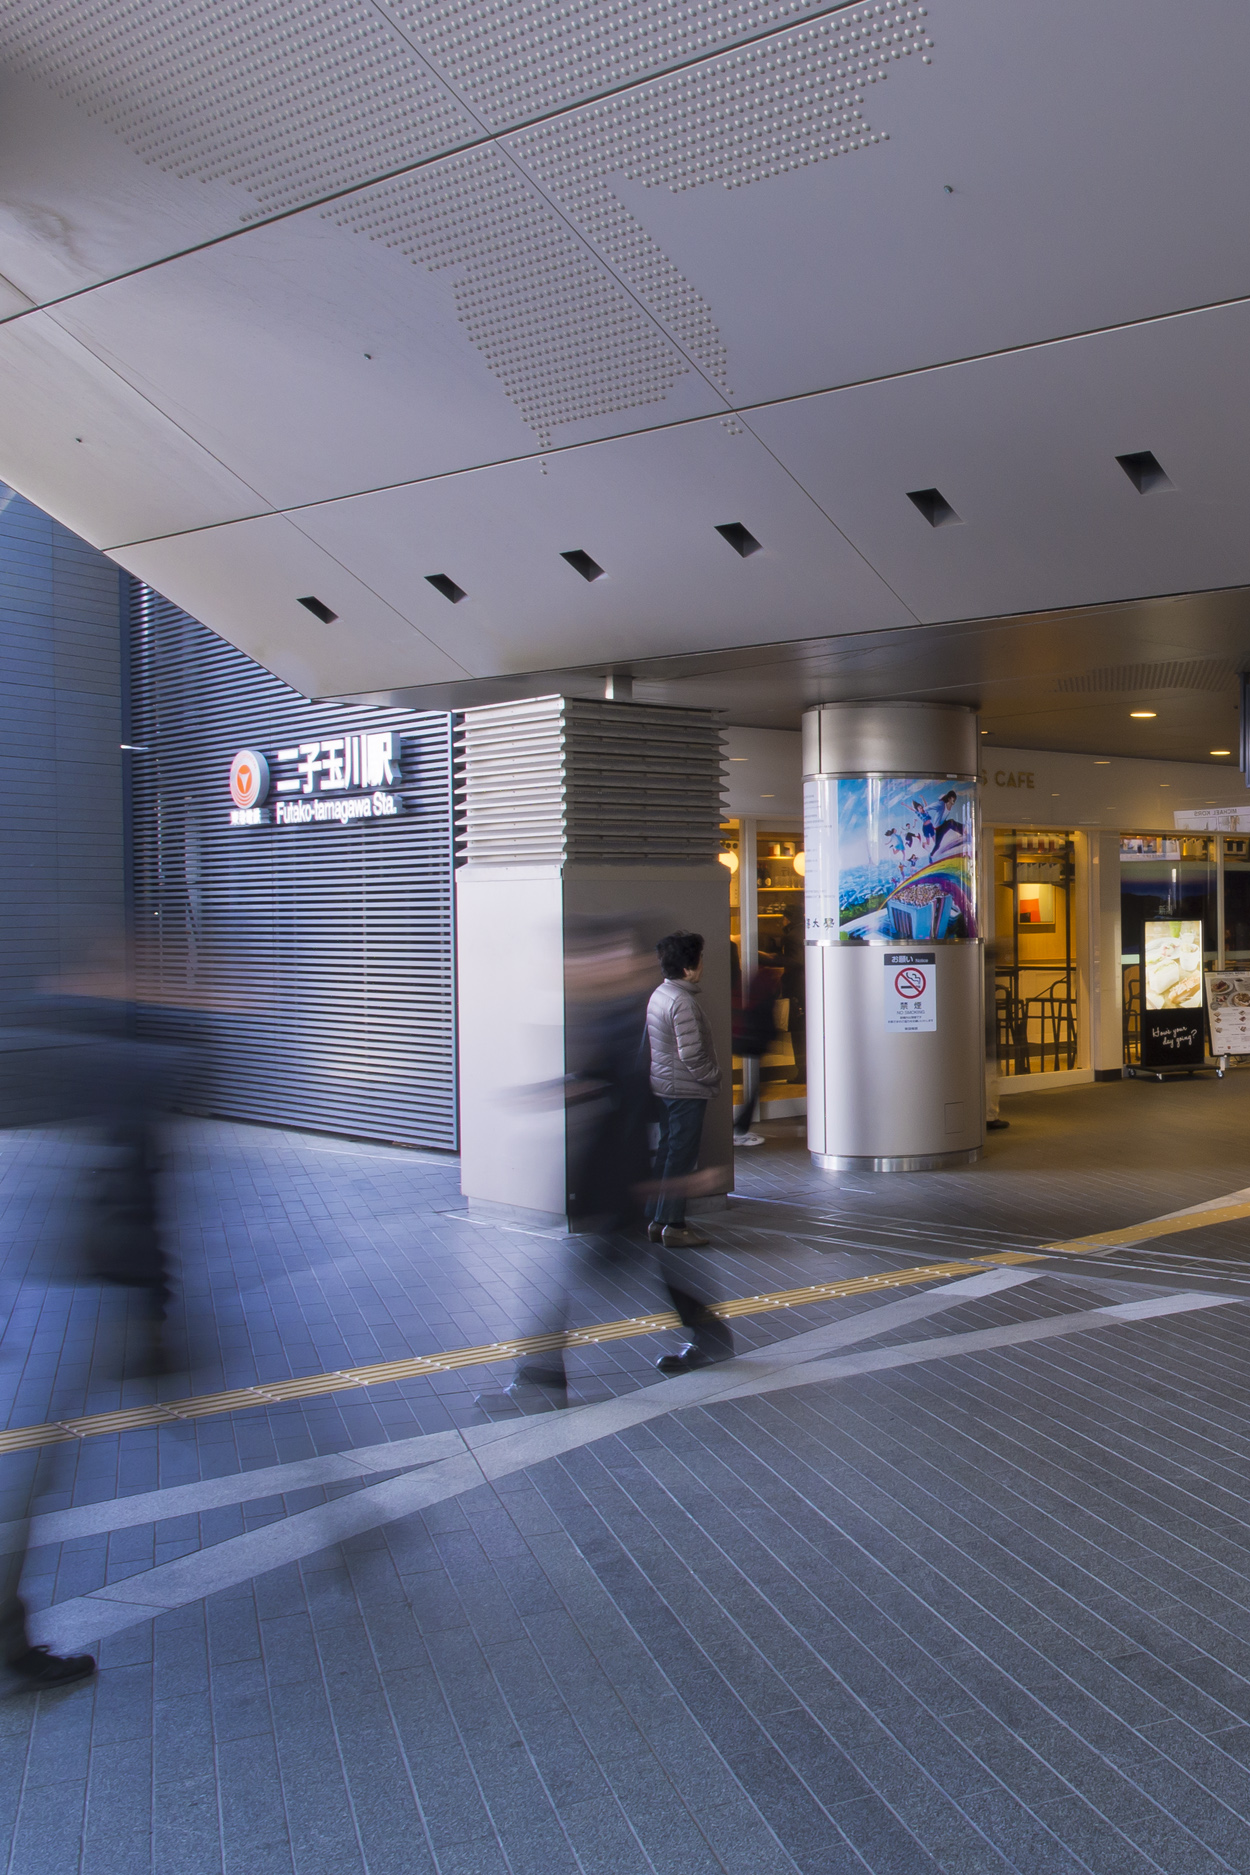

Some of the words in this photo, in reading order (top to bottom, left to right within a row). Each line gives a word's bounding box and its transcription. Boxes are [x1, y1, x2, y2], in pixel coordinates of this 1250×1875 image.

[276, 732, 394, 793] 二子玉川駅
[994, 770, 1034, 789] CAFE
[276, 797, 371, 825] Futako-tamagawa
[372, 791, 397, 816] Sta.
